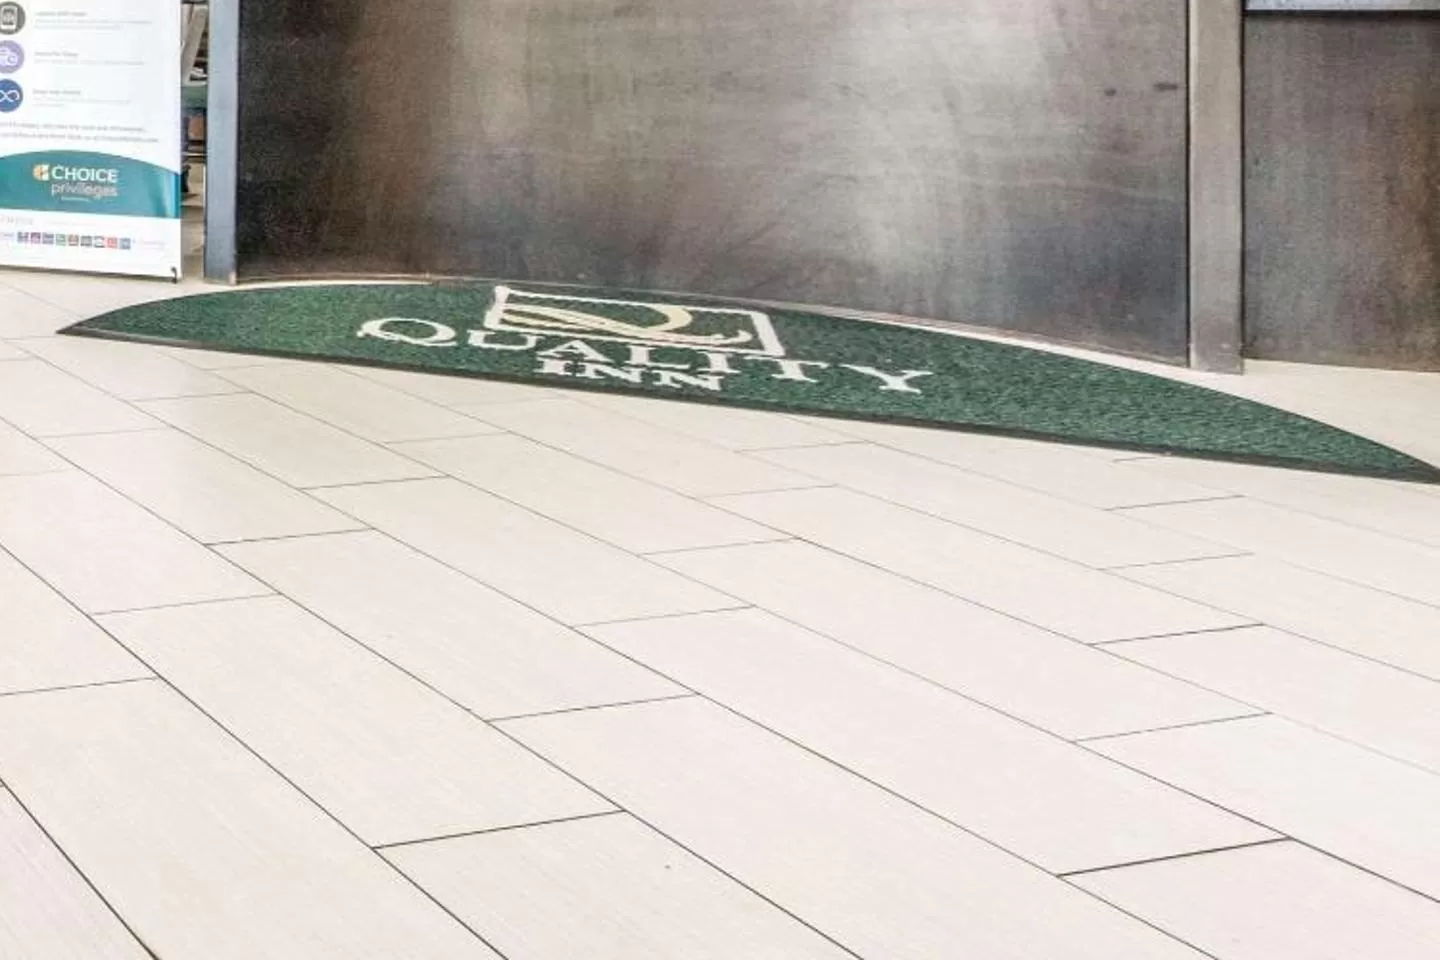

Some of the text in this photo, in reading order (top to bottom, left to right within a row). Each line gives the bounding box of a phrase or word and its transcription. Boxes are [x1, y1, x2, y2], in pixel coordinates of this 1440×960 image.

[51, 165, 118, 183] CHOICE
[51, 181, 118, 199] privileges
[356, 318, 934, 394] QUALITY
[533, 357, 725, 391] INN
